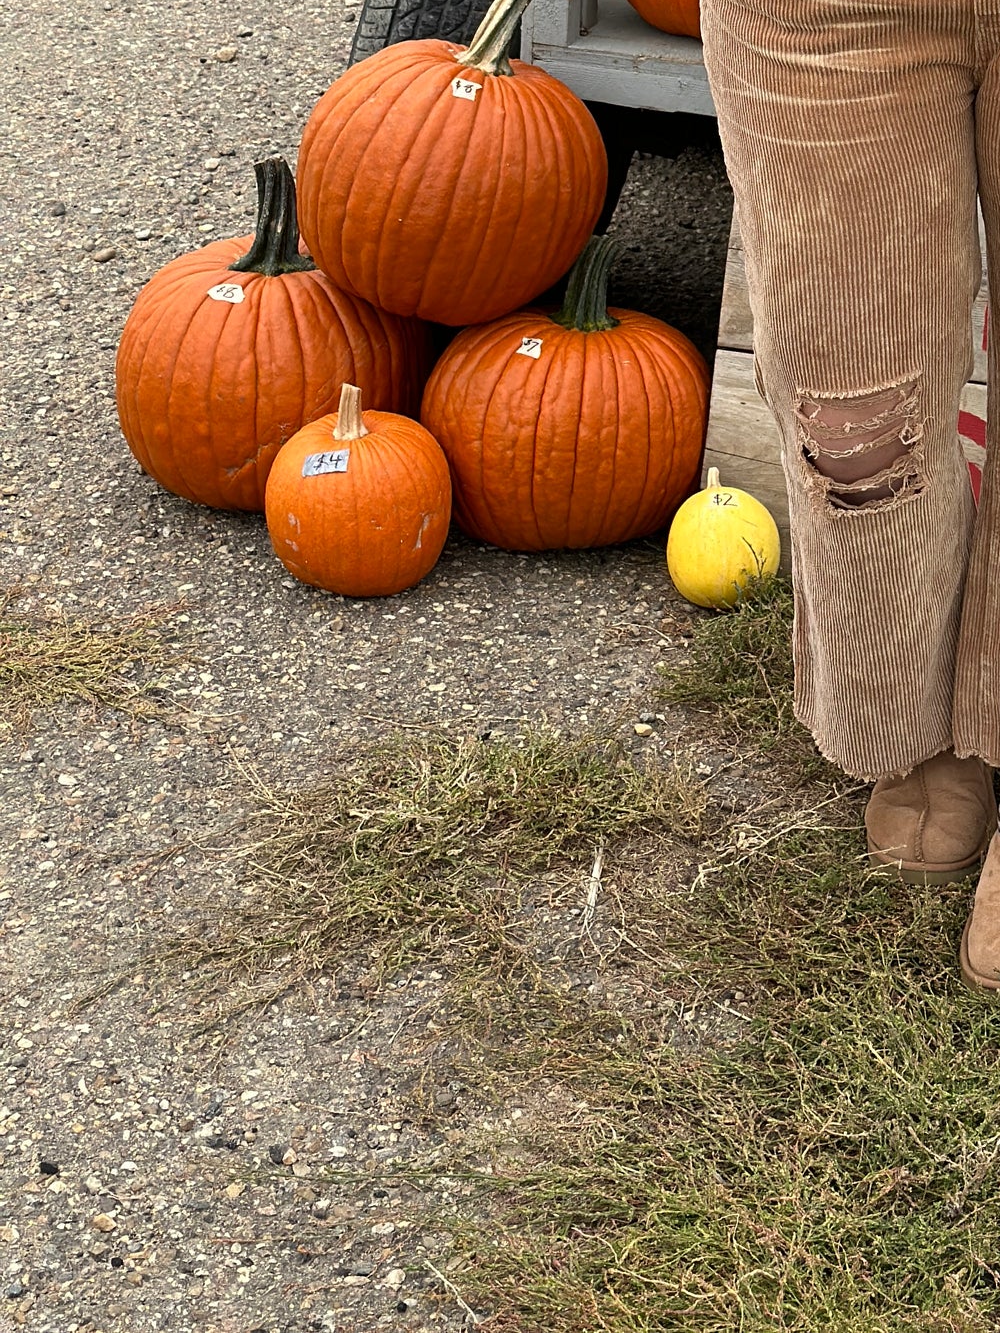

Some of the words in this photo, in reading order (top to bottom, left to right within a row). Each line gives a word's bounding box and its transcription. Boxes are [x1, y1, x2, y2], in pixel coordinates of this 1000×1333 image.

[216, 286, 239, 299] $8
[313, 453, 343, 471] $4
[712, 493, 738, 507] $2
